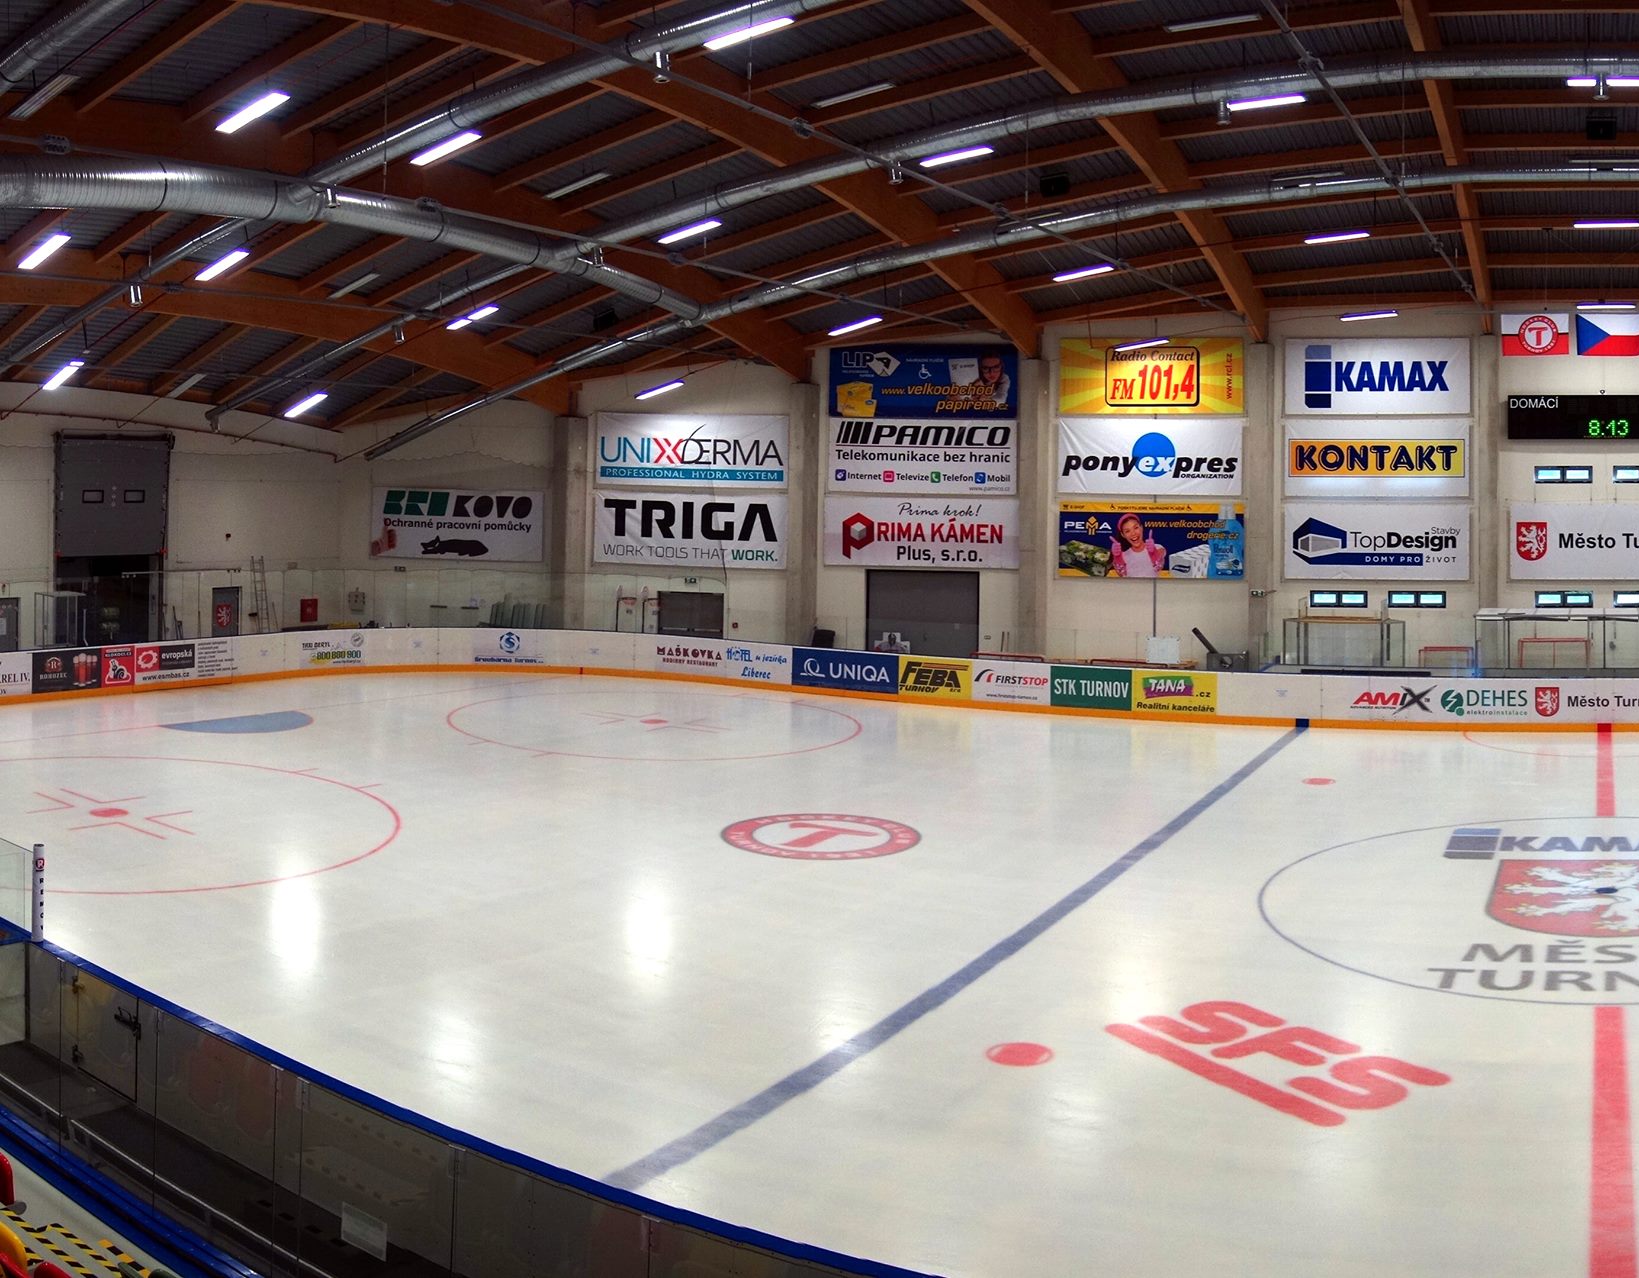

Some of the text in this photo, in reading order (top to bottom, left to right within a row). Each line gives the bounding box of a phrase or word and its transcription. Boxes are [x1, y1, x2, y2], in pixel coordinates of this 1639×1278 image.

[841, 351, 892, 370] LIPA
[1110, 350, 1194, 362] Radio Contact
[1110, 364, 1195, 400] FM 101,4
[1335, 360, 1449, 392] KAMAX
[1509, 396, 1559, 409] DOMÁCÍ
[872, 425, 1011, 446] PAMICO
[836, 450, 1010, 463] Telekomunikace bez hranic
[1295, 444, 1458, 472] KONTAKT
[606, 468, 778, 480] PROFESSIONAL HYDRA SYSTEM
[847, 472, 1011, 482] Internet Televize Telefon Mobil
[452, 495, 533, 519] KOVO
[897, 502, 982, 517] Prima krok!
[384, 518, 532, 533] Ochranné pracovní pomůcky
[604, 498, 778, 542] TRIGA
[930, 518, 1003, 544] KÁMEN
[1431, 526, 1461, 536] Stavby
[1350, 531, 1457, 551] TopDesign
[1558, 533, 1616, 549] Město
[603, 543, 778, 562] WORK TOOLS THAT WORK.
[897, 546, 983, 564] Plus, s.r.o.
[1365, 554, 1457, 563] DOMY PRO ŽIVOT
[161, 649, 193, 661] evropská
[657, 645, 722, 661] MAŠKOVKA
[741, 666, 771, 680] Liberec
[829, 663, 890, 683] UNIQA
[900, 661, 961, 689] FEBA
[995, 675, 1049, 687] FIRSTSTOP
[1054, 678, 1129, 699] STK TURNOV
[1149, 678, 1186, 693] TANA
[1353, 684, 1438, 716] AMIX
[1467, 690, 1528, 707] DEHES
[1567, 695, 1610, 708] Město
[1136, 702, 1215, 713] Realitní kanceláře
[1138, 1000, 1452, 1110] SFS
